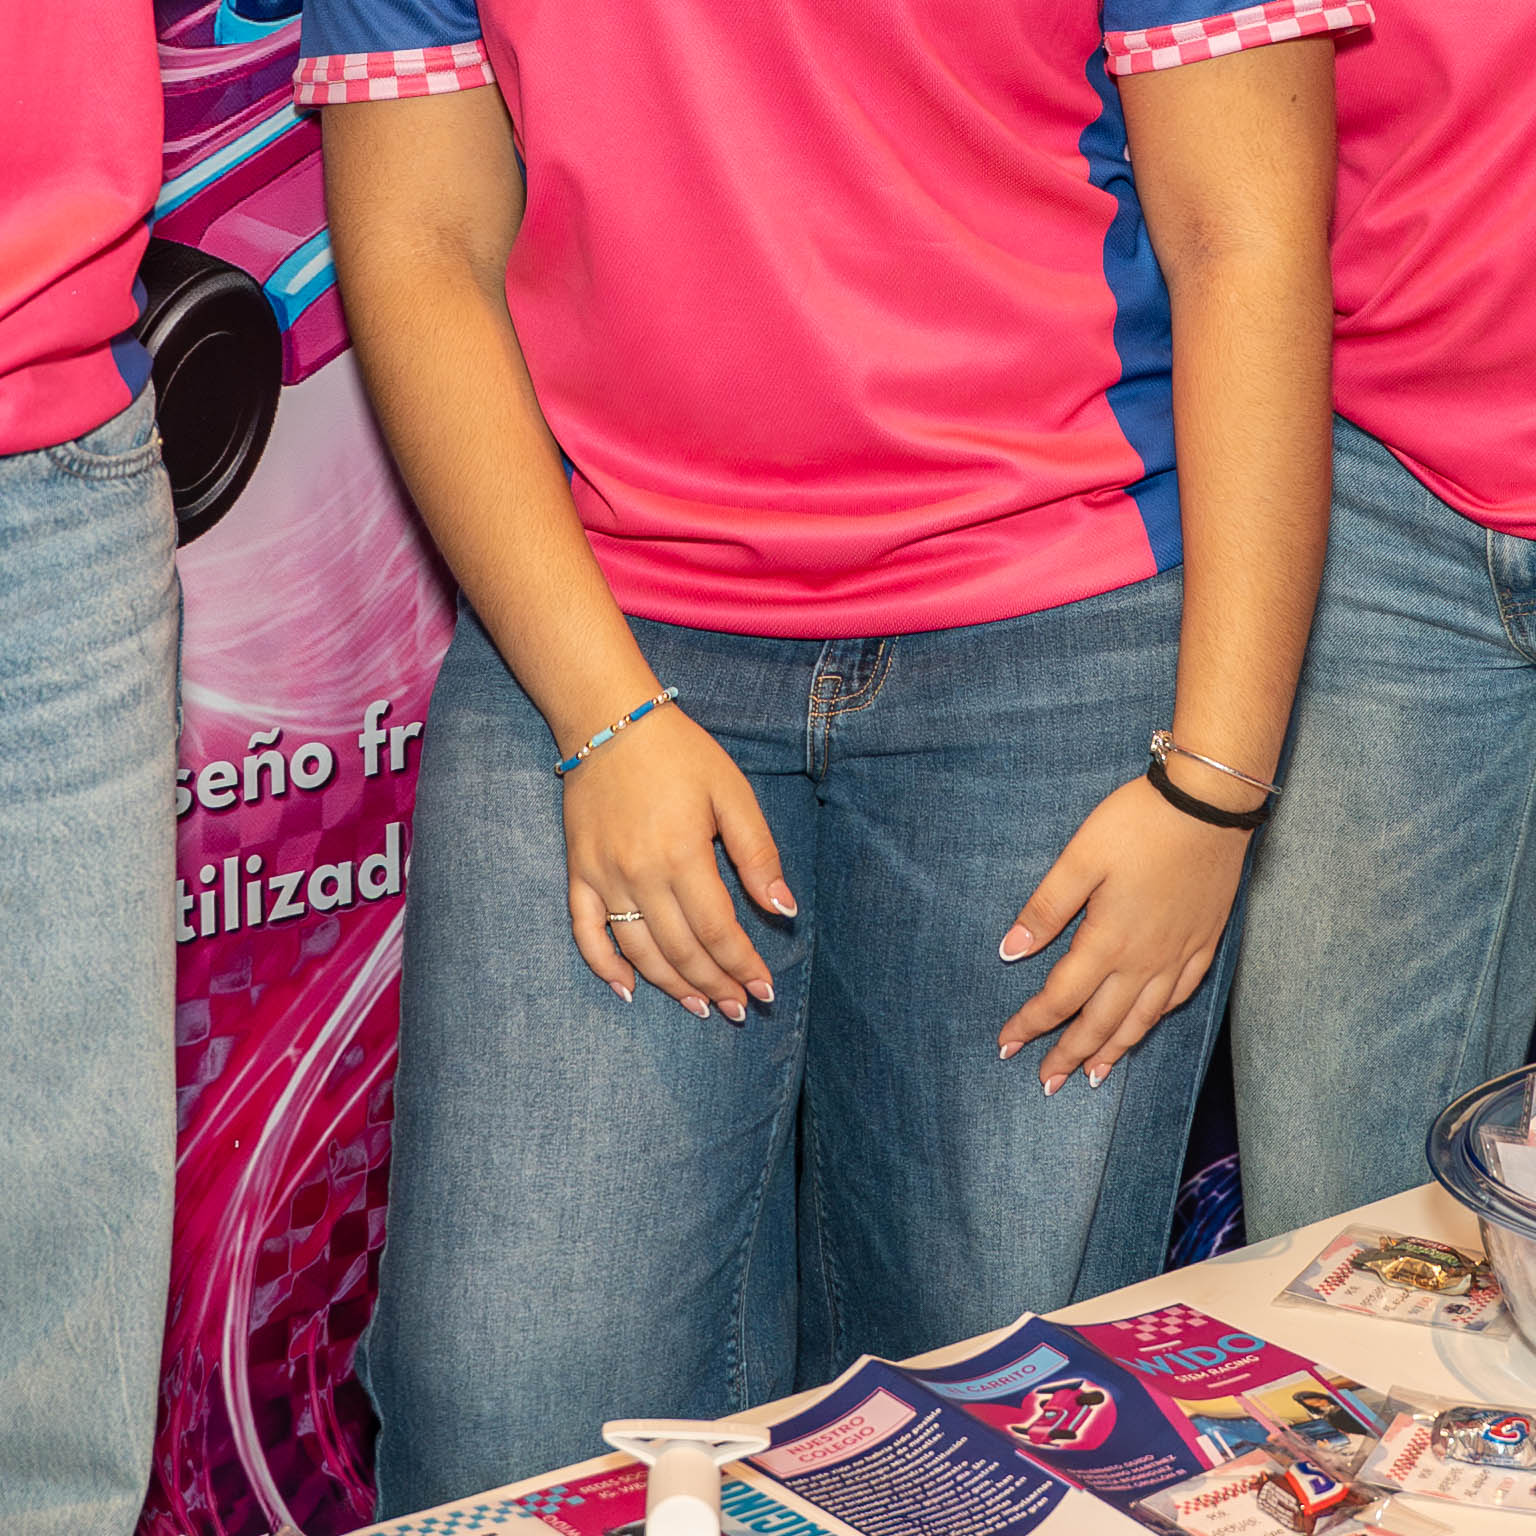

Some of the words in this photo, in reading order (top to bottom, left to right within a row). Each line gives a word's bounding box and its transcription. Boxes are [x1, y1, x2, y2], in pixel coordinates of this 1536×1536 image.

[176, 821, 412, 944] tilizad
[1117, 1333, 1266, 1376] WIDO
[1175, 1370, 1212, 1383] STEM
[1205, 1354, 1260, 1376] RACING
[966, 1364, 1037, 1394] CARRITO
[786, 1415, 865, 1455] NUESTRO
[798, 1425, 875, 1463] COLEGIO
